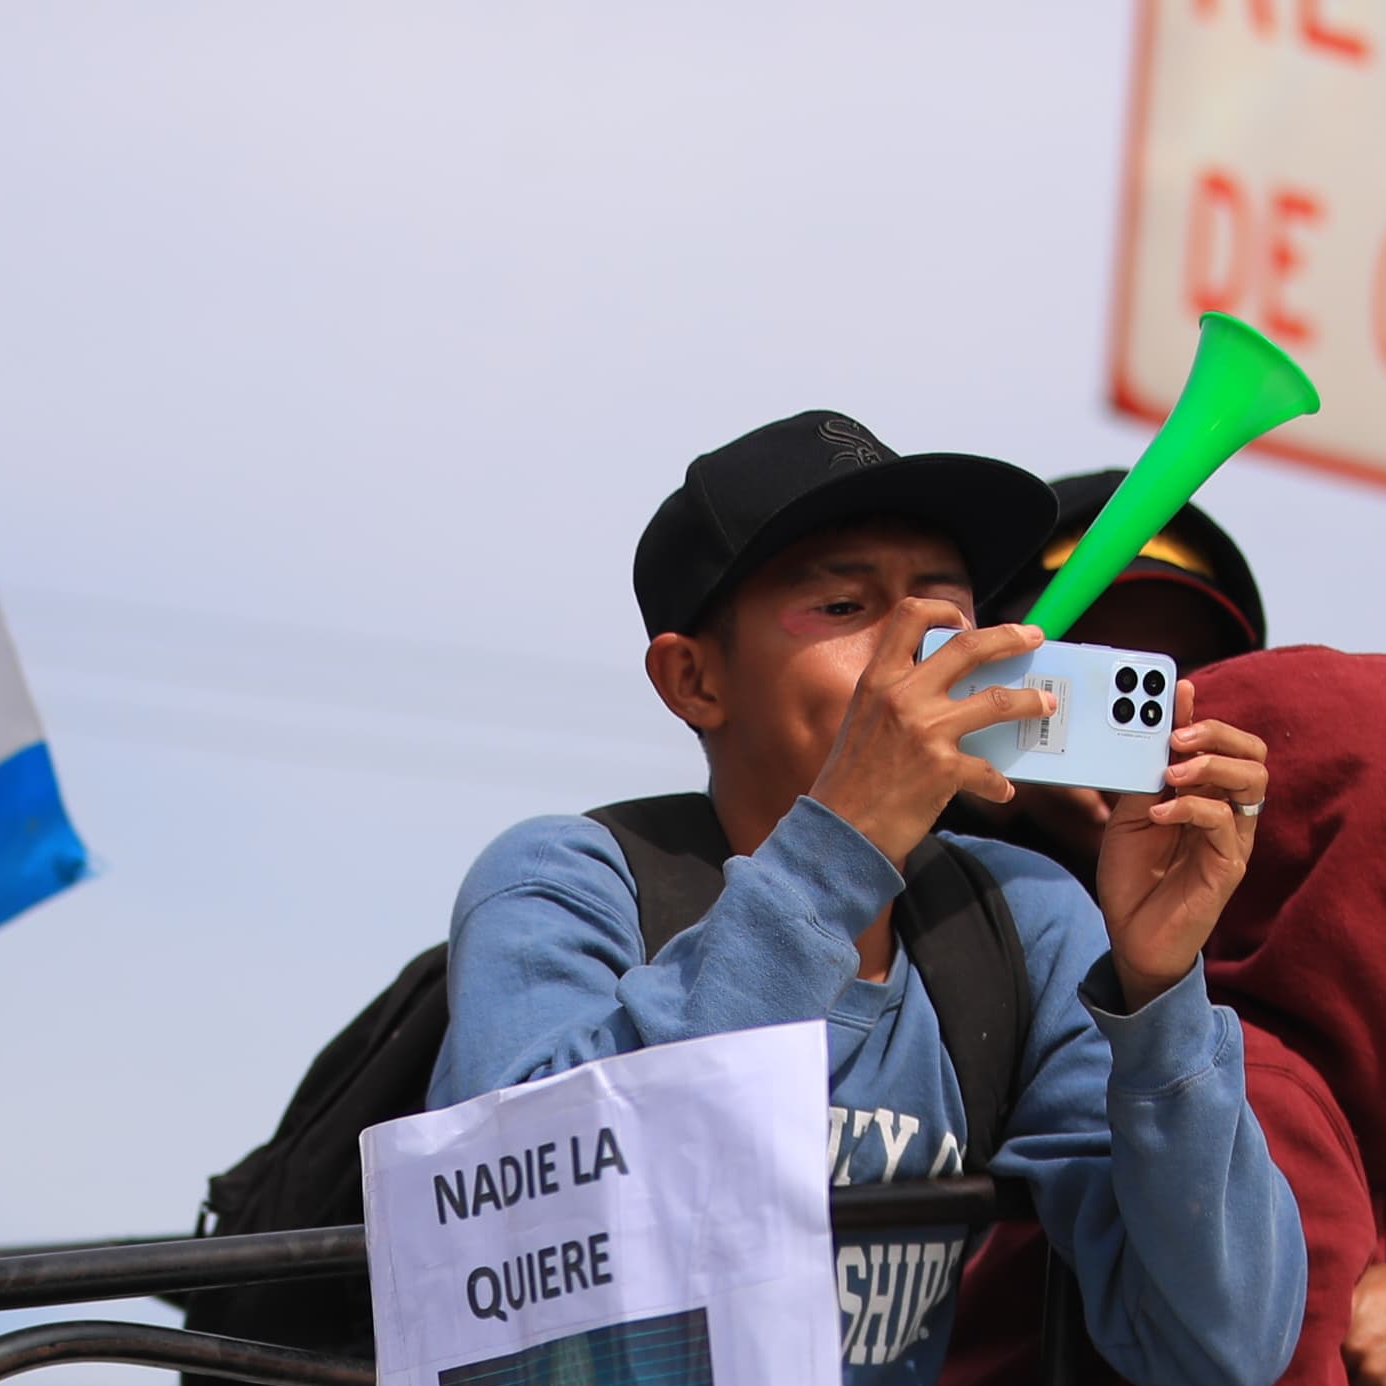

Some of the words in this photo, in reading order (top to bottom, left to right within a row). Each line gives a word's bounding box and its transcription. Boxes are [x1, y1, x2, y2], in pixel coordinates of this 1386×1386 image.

[1183, 170, 1325, 350] DE
[434, 1141, 559, 1225] NADIE
[571, 1127, 629, 1185] LA
[466, 1232, 613, 1322] QUIERE
